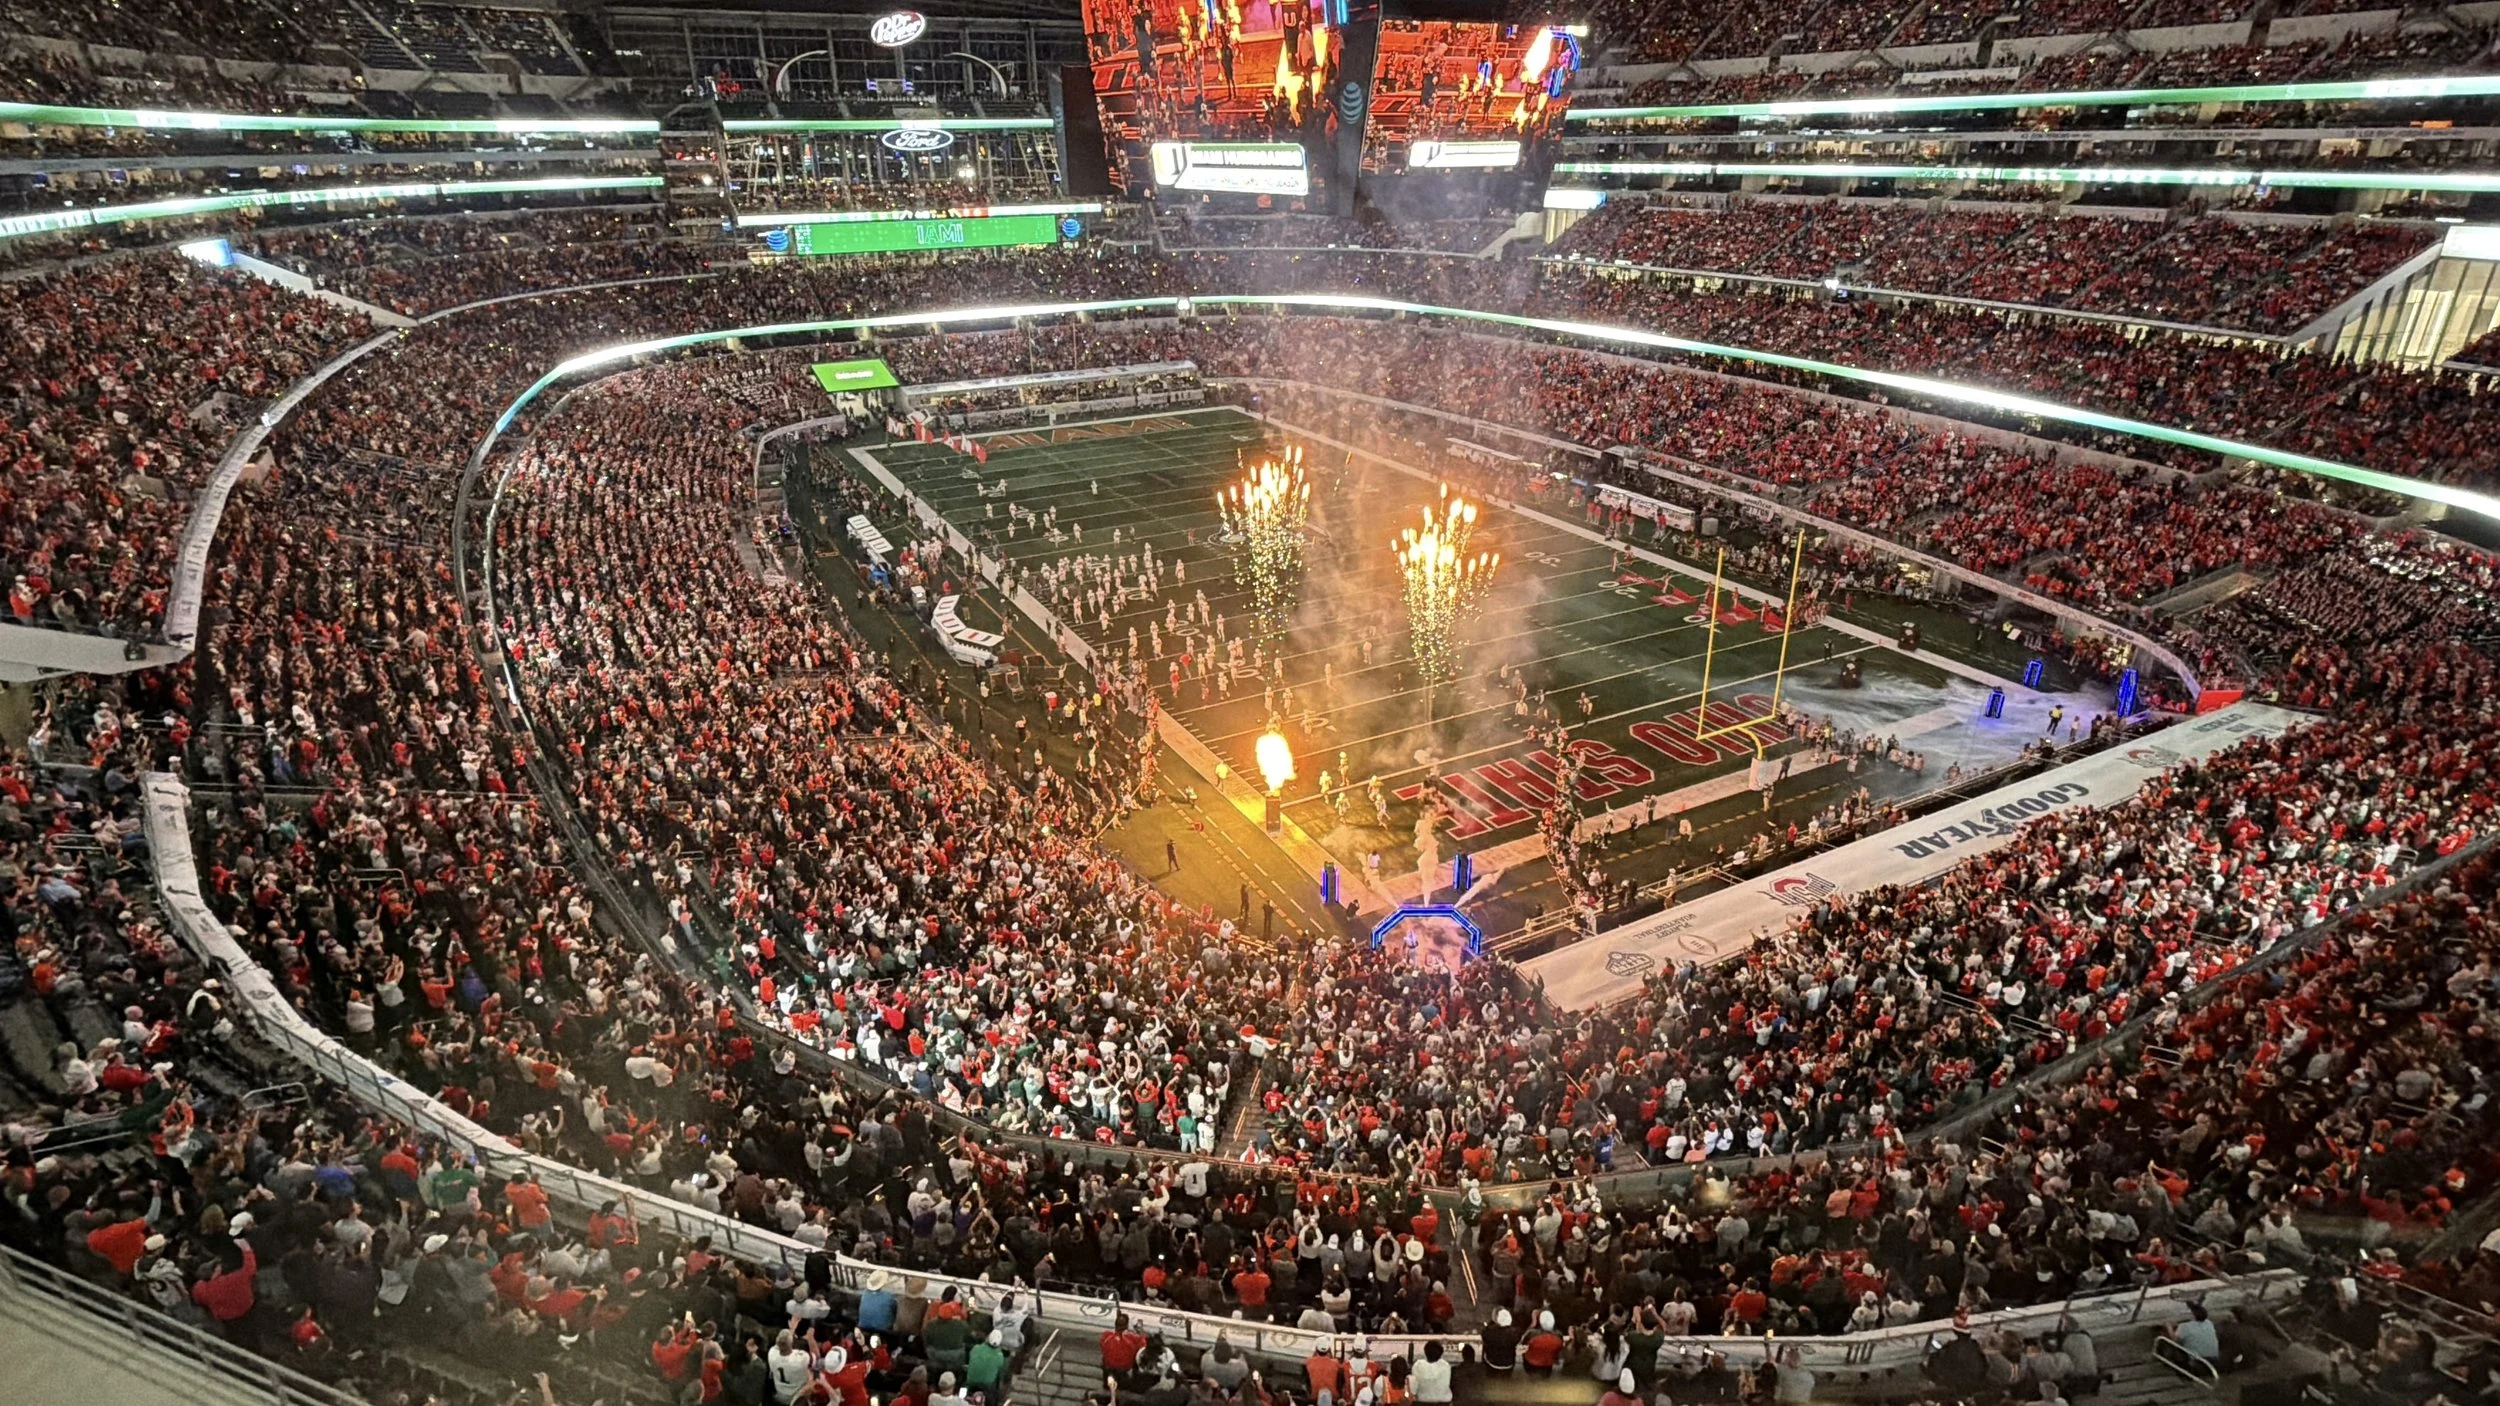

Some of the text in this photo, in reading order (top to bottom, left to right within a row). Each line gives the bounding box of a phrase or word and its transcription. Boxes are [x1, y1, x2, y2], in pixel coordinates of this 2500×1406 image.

[895, 130, 941, 147] Ford
[1629, 693, 1796, 766] OHIO
[1895, 782, 2090, 860] GOODYEAR
[777, 1366, 791, 1384] 1
